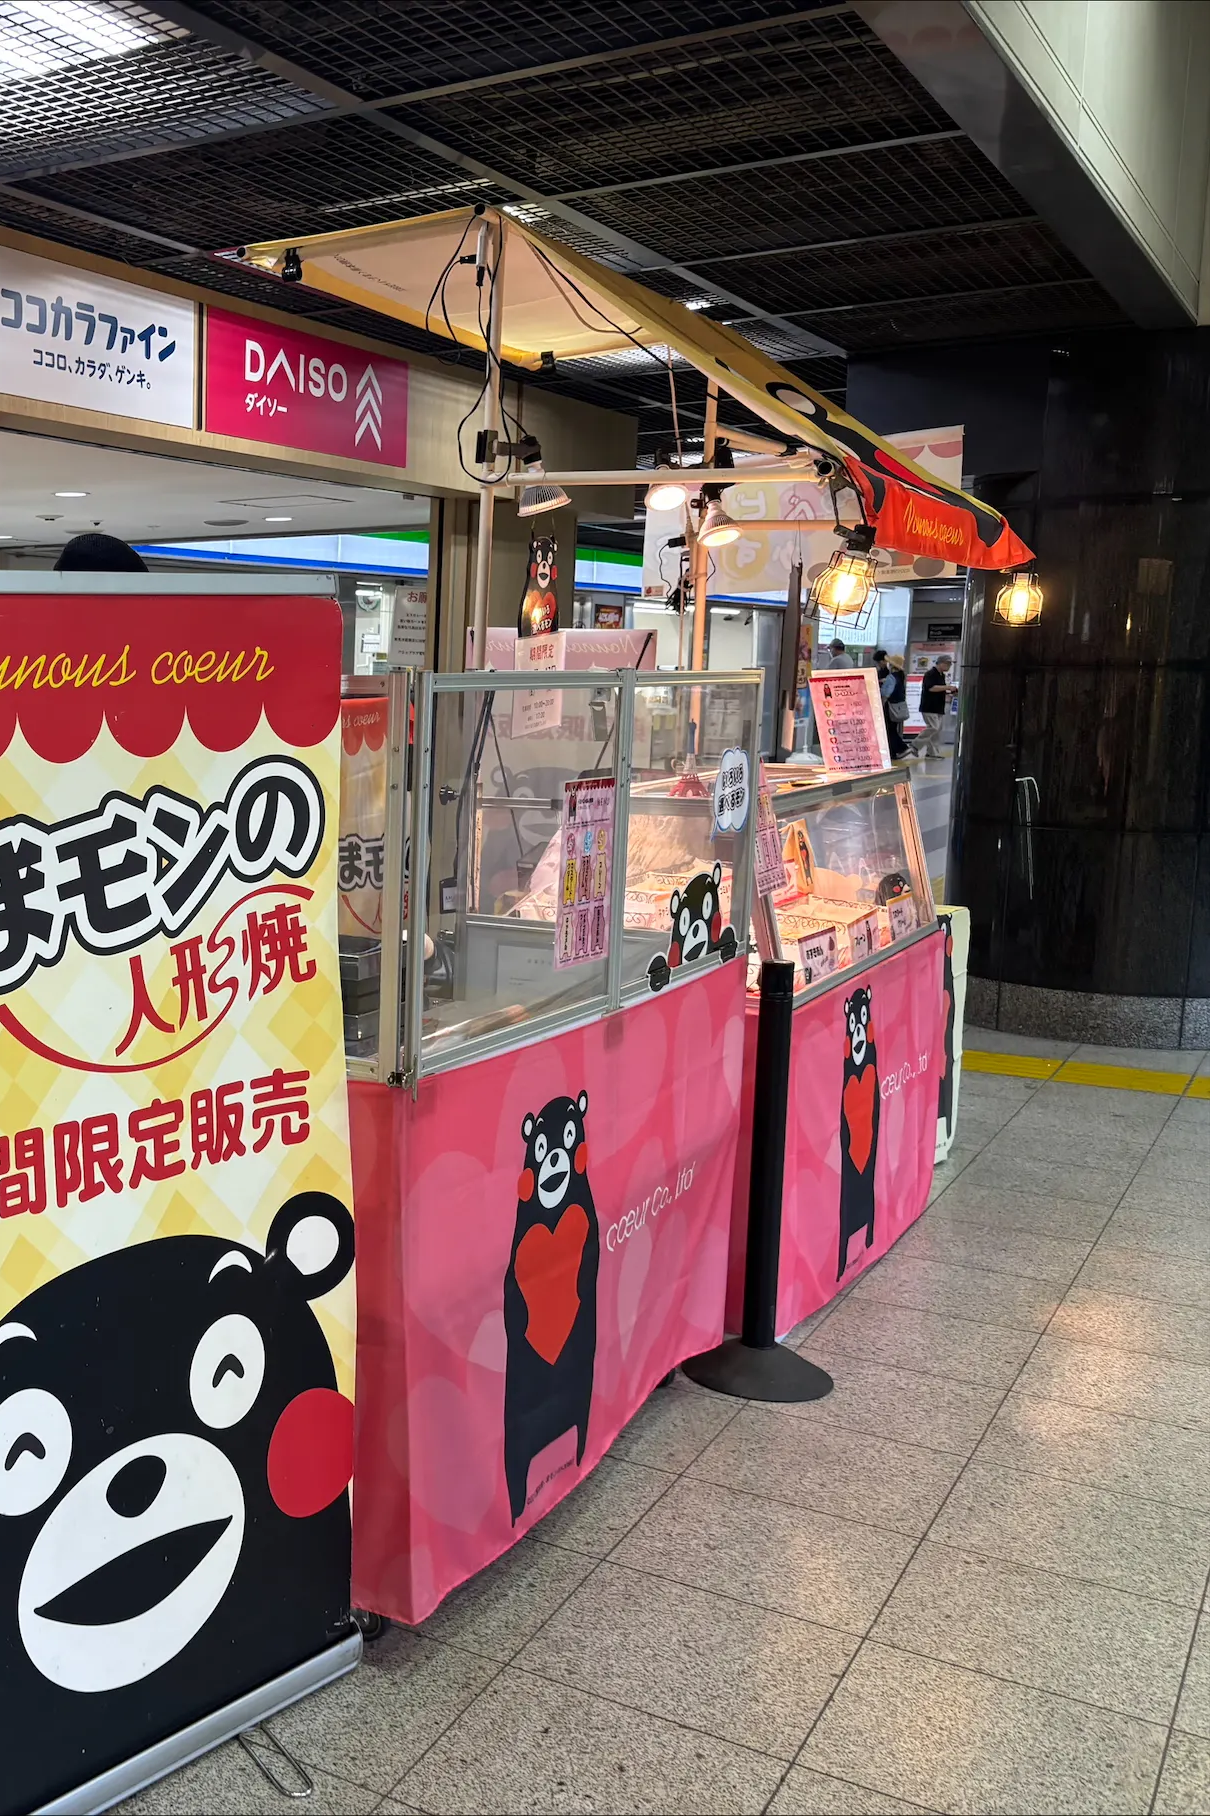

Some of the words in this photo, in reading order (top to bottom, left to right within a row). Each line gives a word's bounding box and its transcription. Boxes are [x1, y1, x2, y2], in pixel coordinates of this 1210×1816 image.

[0, 287, 177, 363] ココカラファイン
[32, 347, 152, 391] ココロ、カラダ、ゲンキ。
[244, 338, 348, 404] DAISO
[244, 391, 289, 417] ダイソー
[150, 645, 275, 685] coeur
[115, 903, 318, 1058] 人形焼
